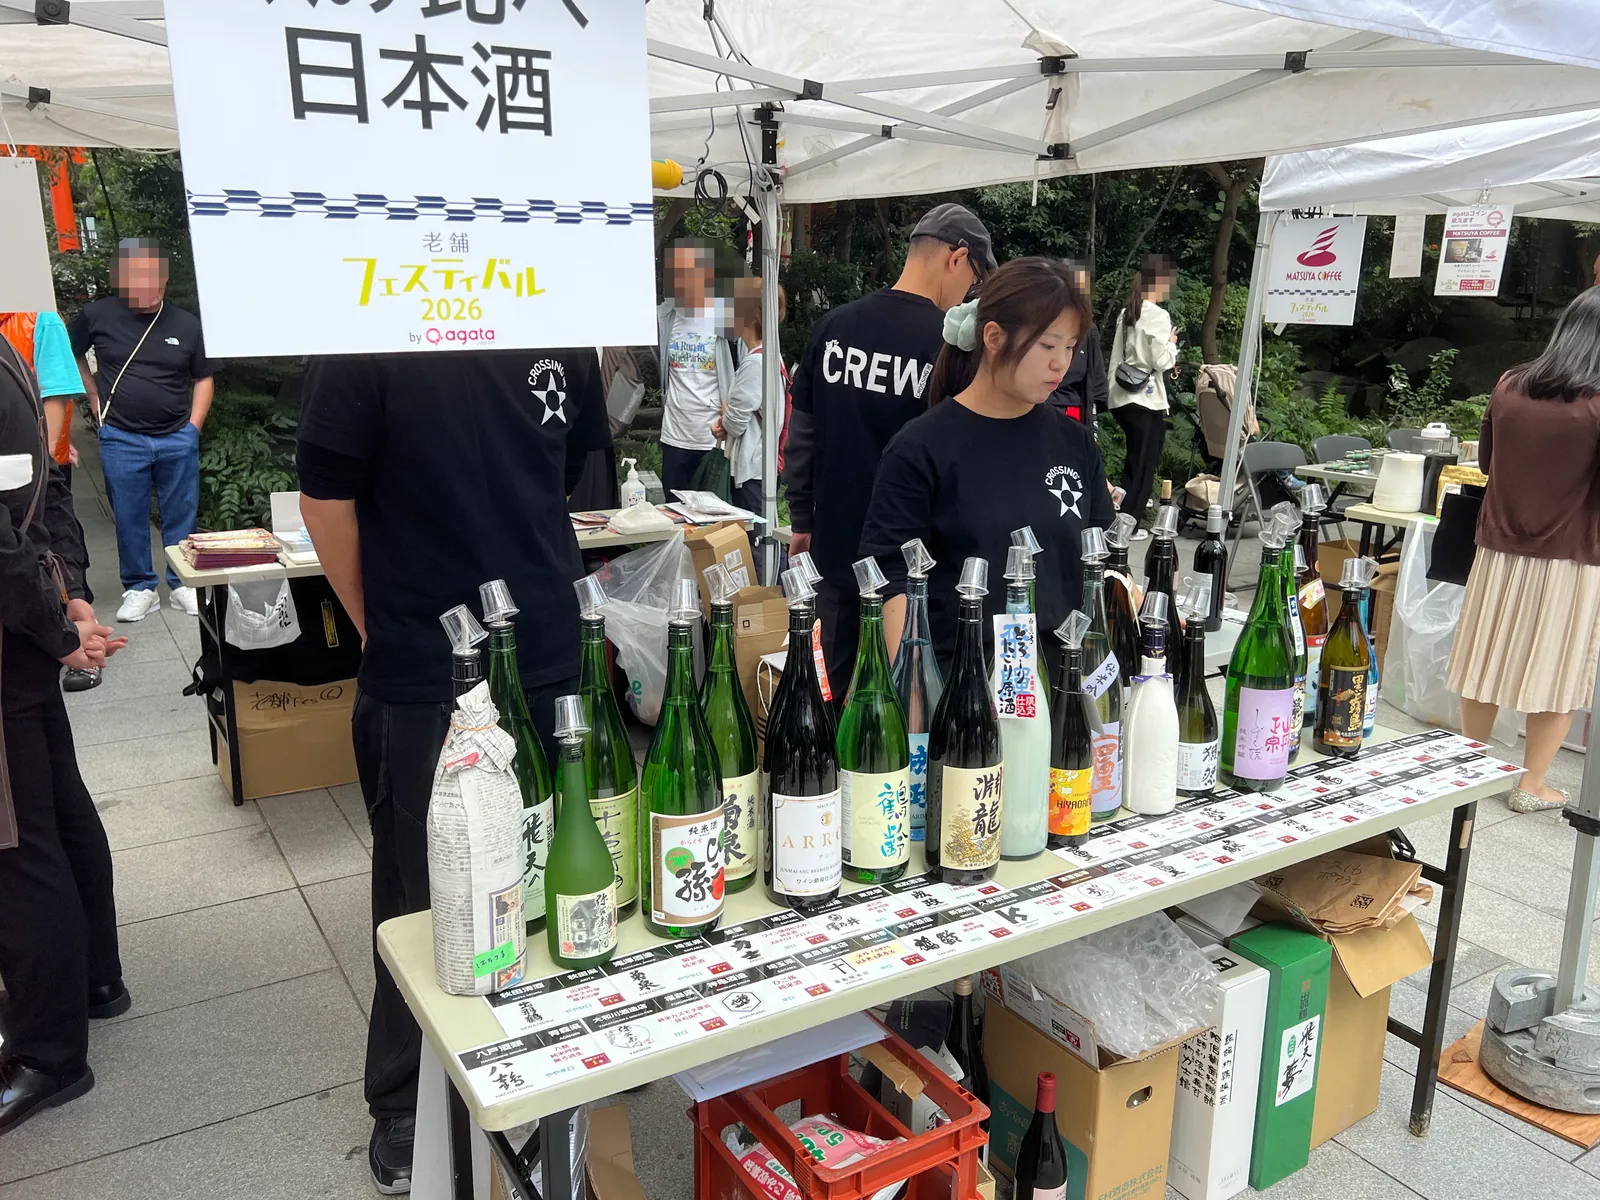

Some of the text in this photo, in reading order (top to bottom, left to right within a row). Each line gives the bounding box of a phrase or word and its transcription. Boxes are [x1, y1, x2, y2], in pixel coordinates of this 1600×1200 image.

[284, 26, 552, 136] 日本酒
[422, 232, 469, 253] 老舗
[342, 258, 546, 306] フェスティバル
[1286, 271, 1342, 281] MATSUYA COFFEE
[420, 298, 483, 321] 2026
[409, 332, 421, 344] by
[822, 343, 934, 399] CREW
[1044, 465, 1080, 486] CROSSING
[688, 820, 718, 836] 純米酒
[590, 1002, 648, 1023] 大和川酒造店
[742, 1158, 785, 1198] ごみ収集袋
